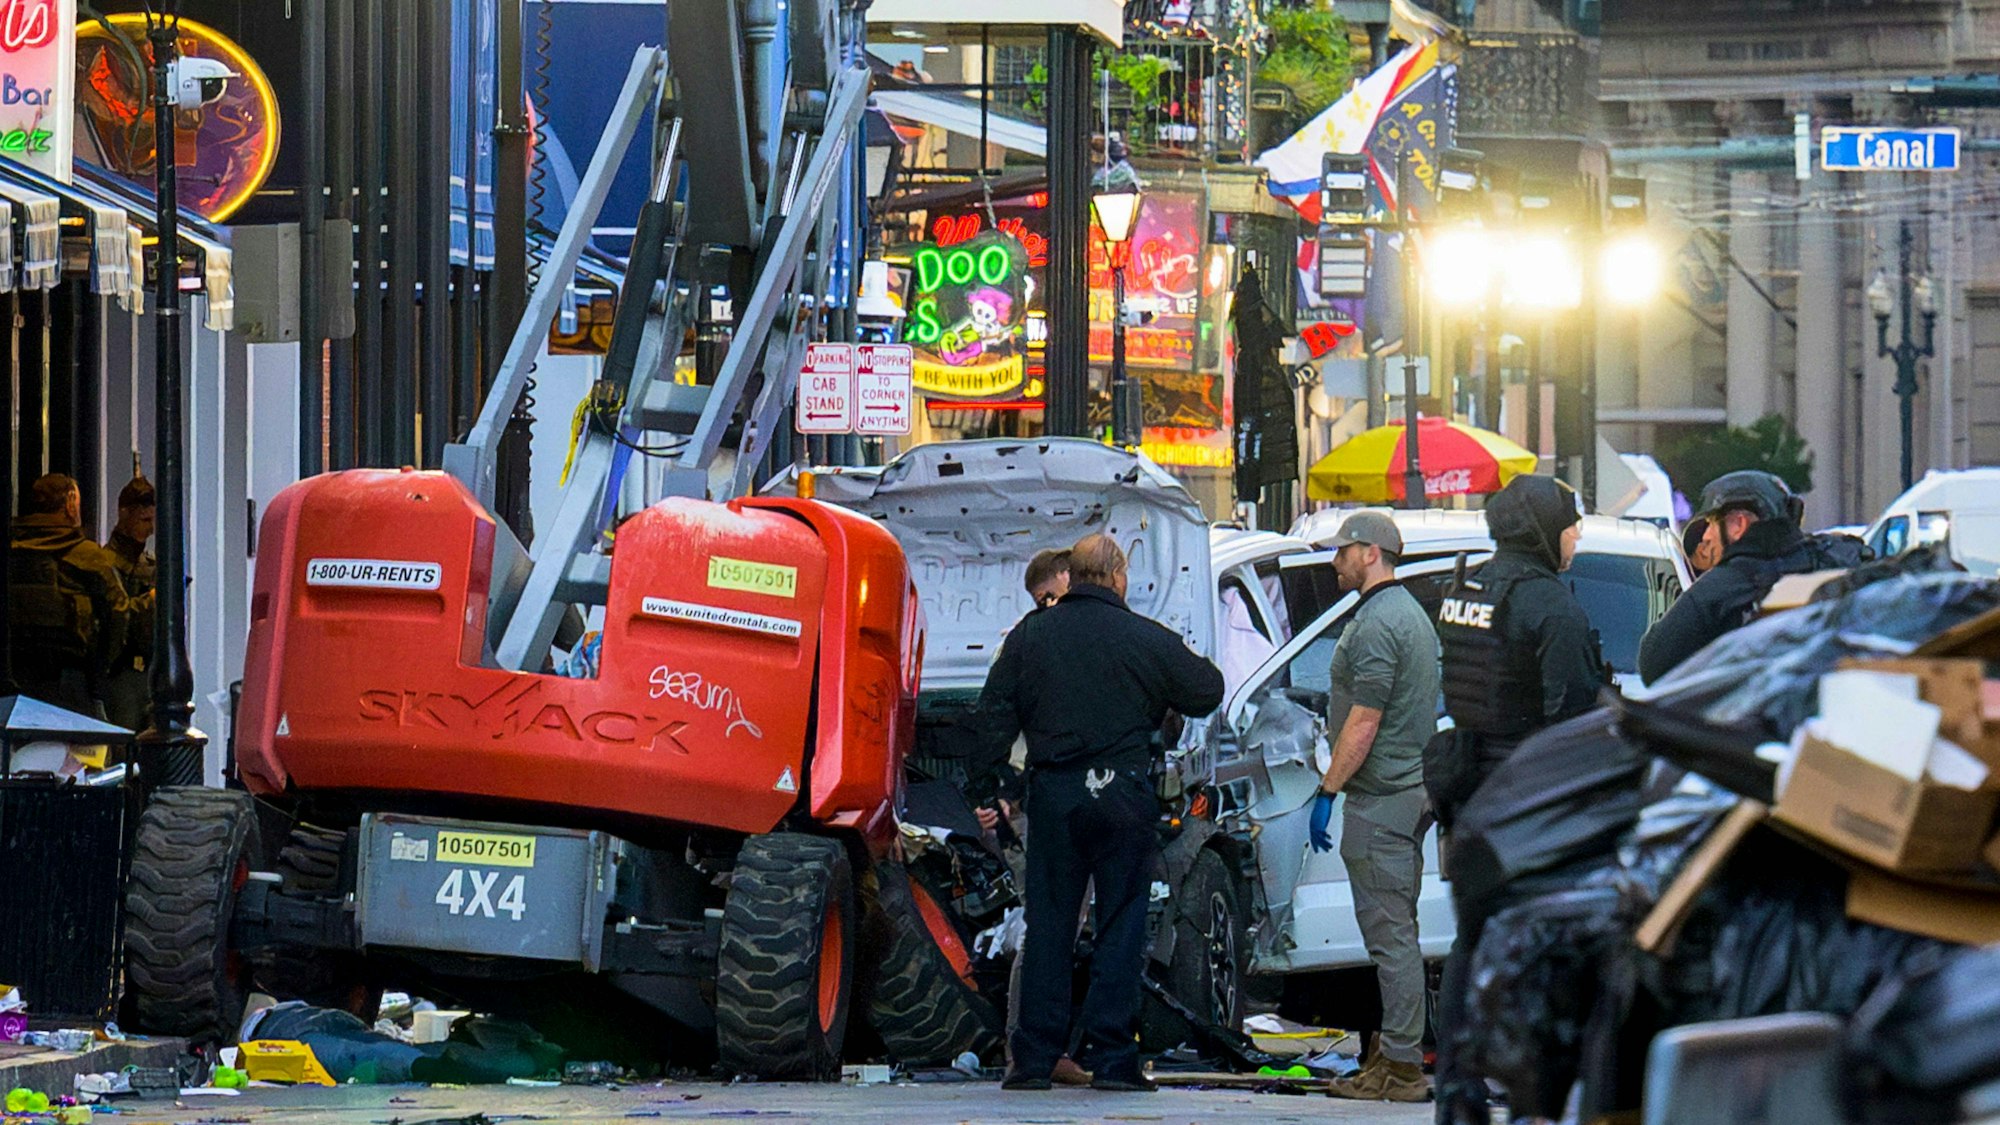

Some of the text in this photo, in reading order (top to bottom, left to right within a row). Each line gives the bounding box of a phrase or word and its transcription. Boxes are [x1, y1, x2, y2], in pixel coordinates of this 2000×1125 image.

[3, 73, 52, 105] Bar
[1857, 132, 1935, 169] Canal
[814, 353, 850, 366] PARKING
[873, 354, 910, 367] STOPPING
[812, 376, 837, 391] CAB
[877, 376, 891, 387] TO
[924, 369, 943, 386] BE
[946, 373, 984, 389] WITH
[989, 365, 1018, 387] YOU
[805, 396, 845, 411] STAND
[861, 388, 906, 401] CORNER
[859, 415, 907, 430] ANYTIME
[310, 563, 436, 584] 1-800-UR-RENTS
[710, 563, 794, 590] 10507501
[645, 602, 797, 635] www.unitedrentals.com
[358, 678, 690, 756] SKYJACK
[439, 837, 532, 859] 10507501
[435, 868, 526, 921] 4X4
